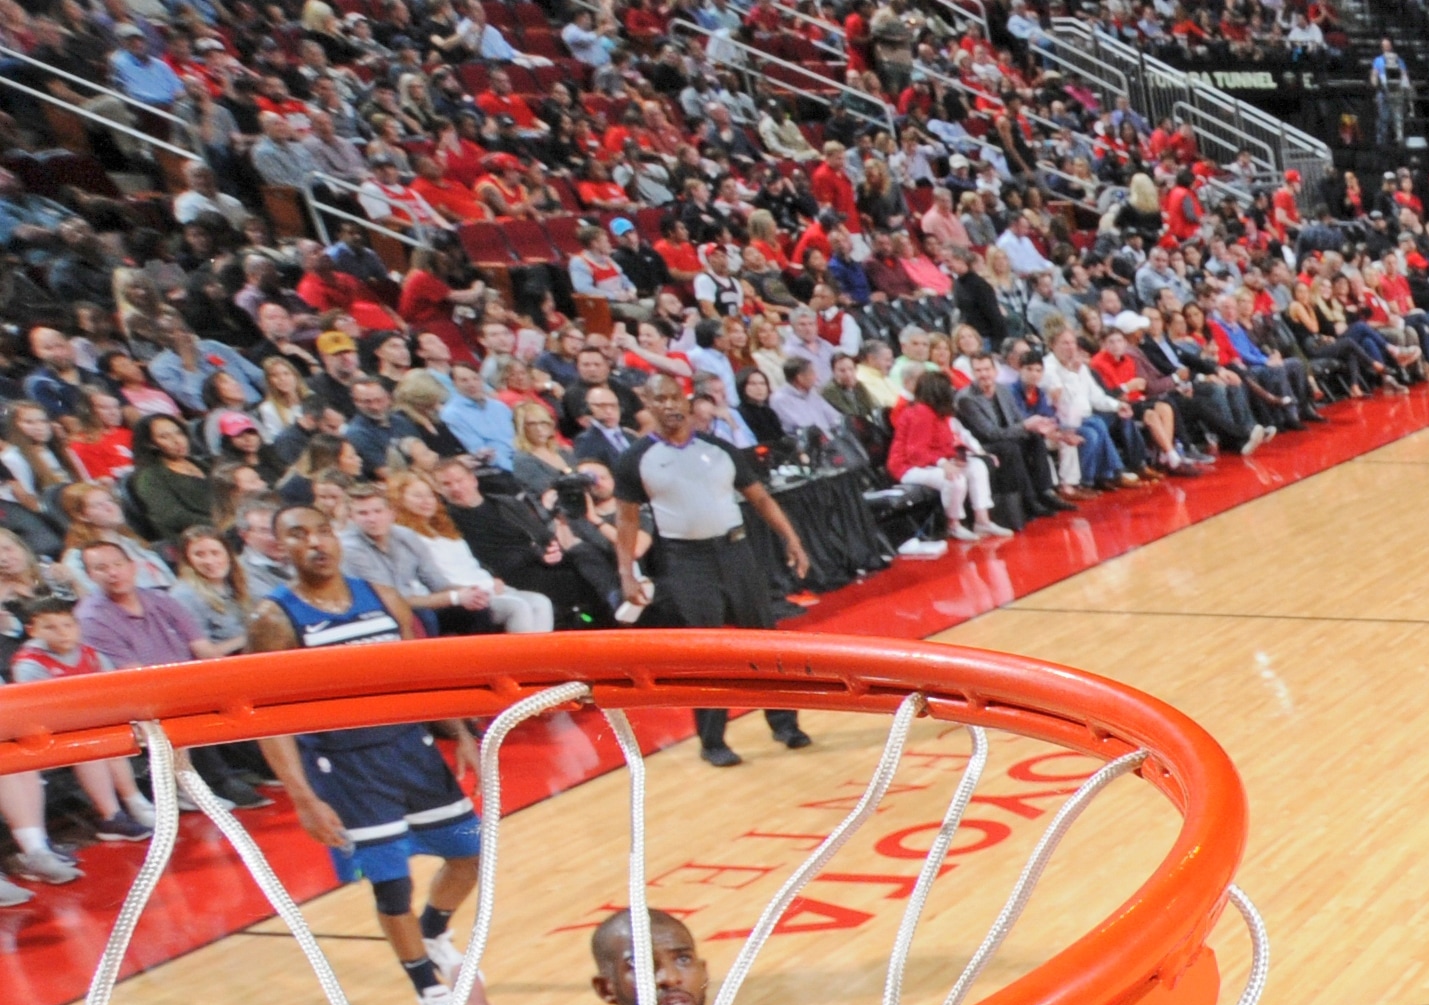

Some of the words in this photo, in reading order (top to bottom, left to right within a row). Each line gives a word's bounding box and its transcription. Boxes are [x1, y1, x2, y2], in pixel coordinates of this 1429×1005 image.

[1212, 71, 1278, 89] TUNNEL
[542, 724, 963, 937] ENTER
[703, 735, 1110, 941] OYOTA
